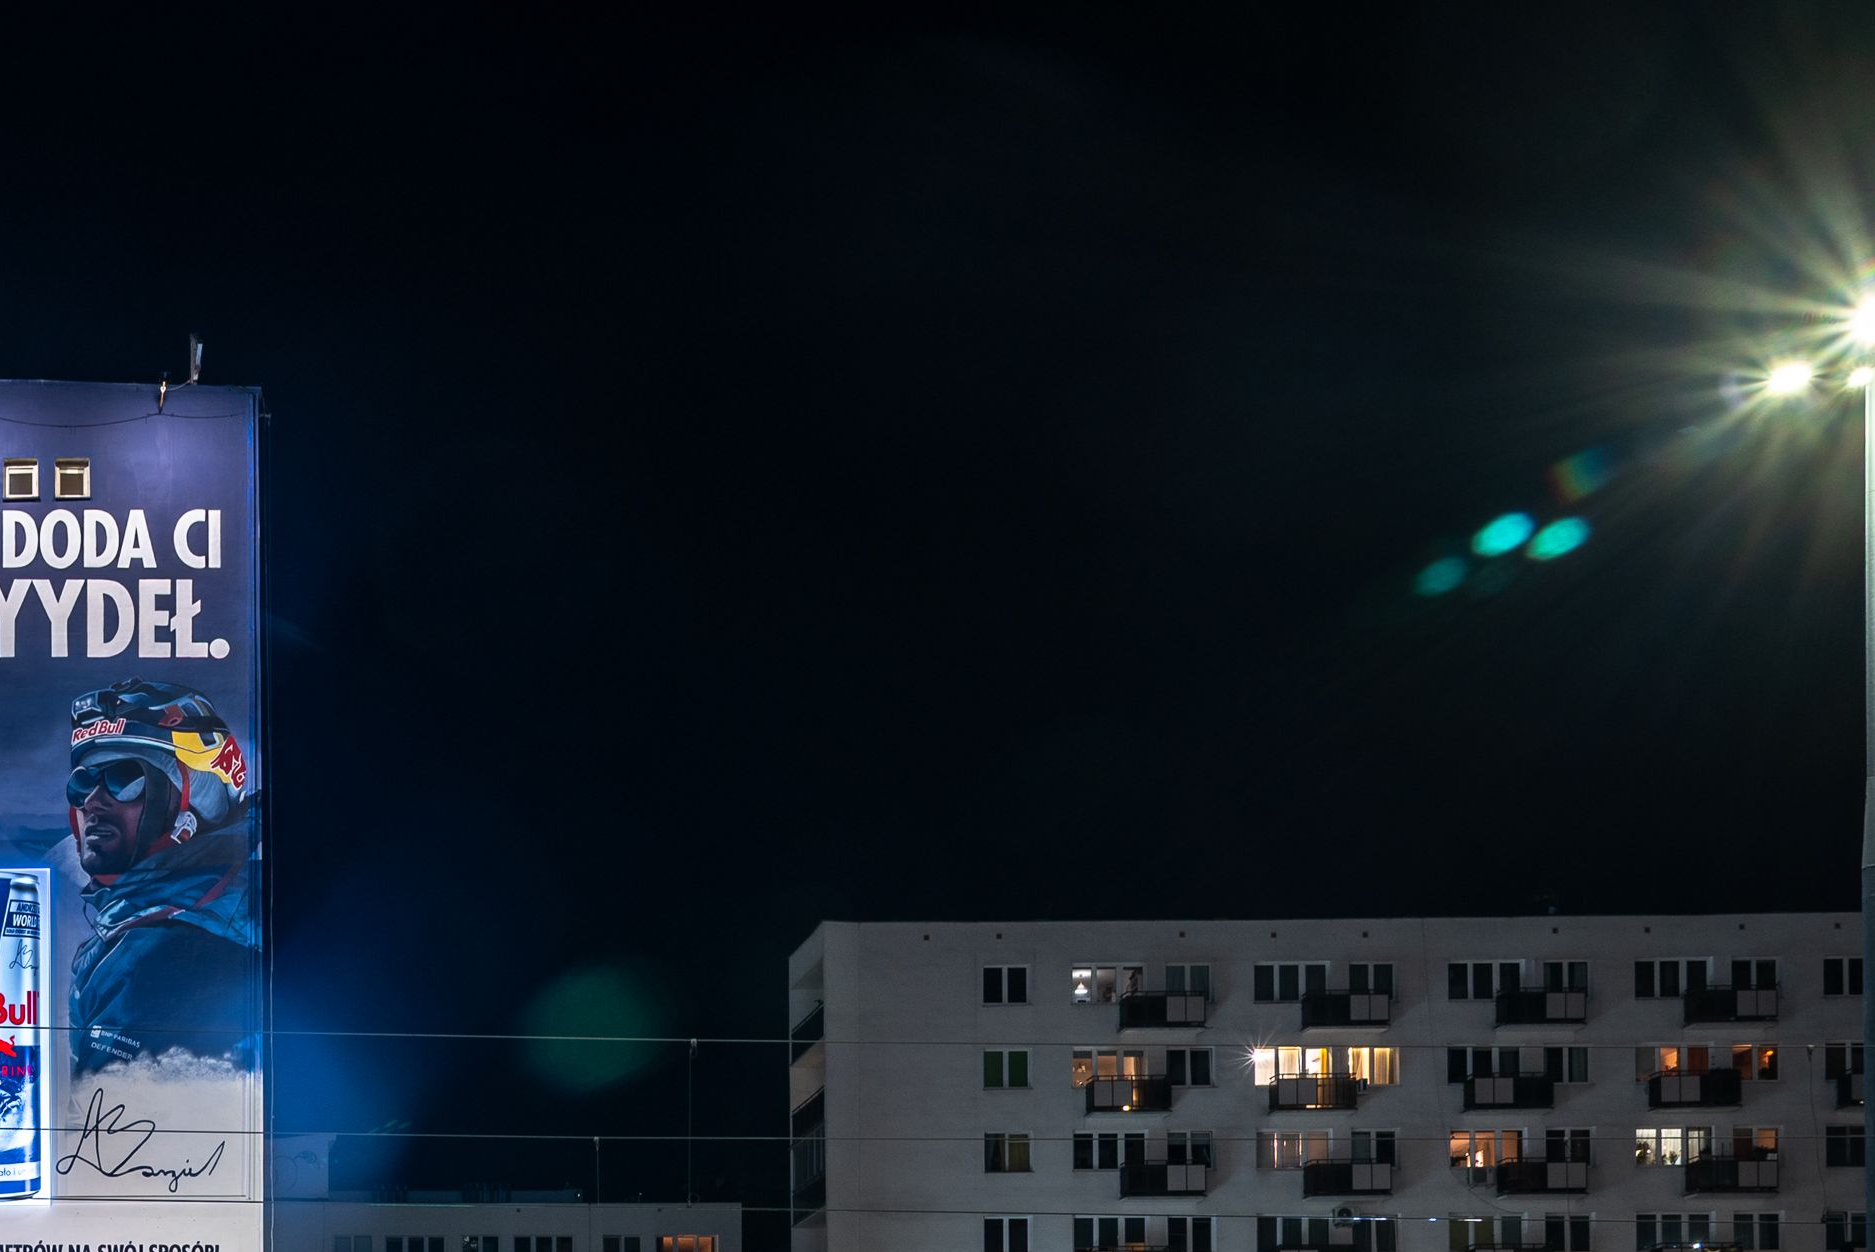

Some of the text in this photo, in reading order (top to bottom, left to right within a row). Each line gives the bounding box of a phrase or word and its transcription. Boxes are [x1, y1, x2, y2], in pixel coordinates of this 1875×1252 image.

[2, 508, 158, 569] DODA
[173, 508, 222, 569] CI
[73, 717, 126, 743] Red Bull
[101, 1030, 140, 1048] BNP PARIBAS
[91, 1041, 133, 1060] DEFENDER
